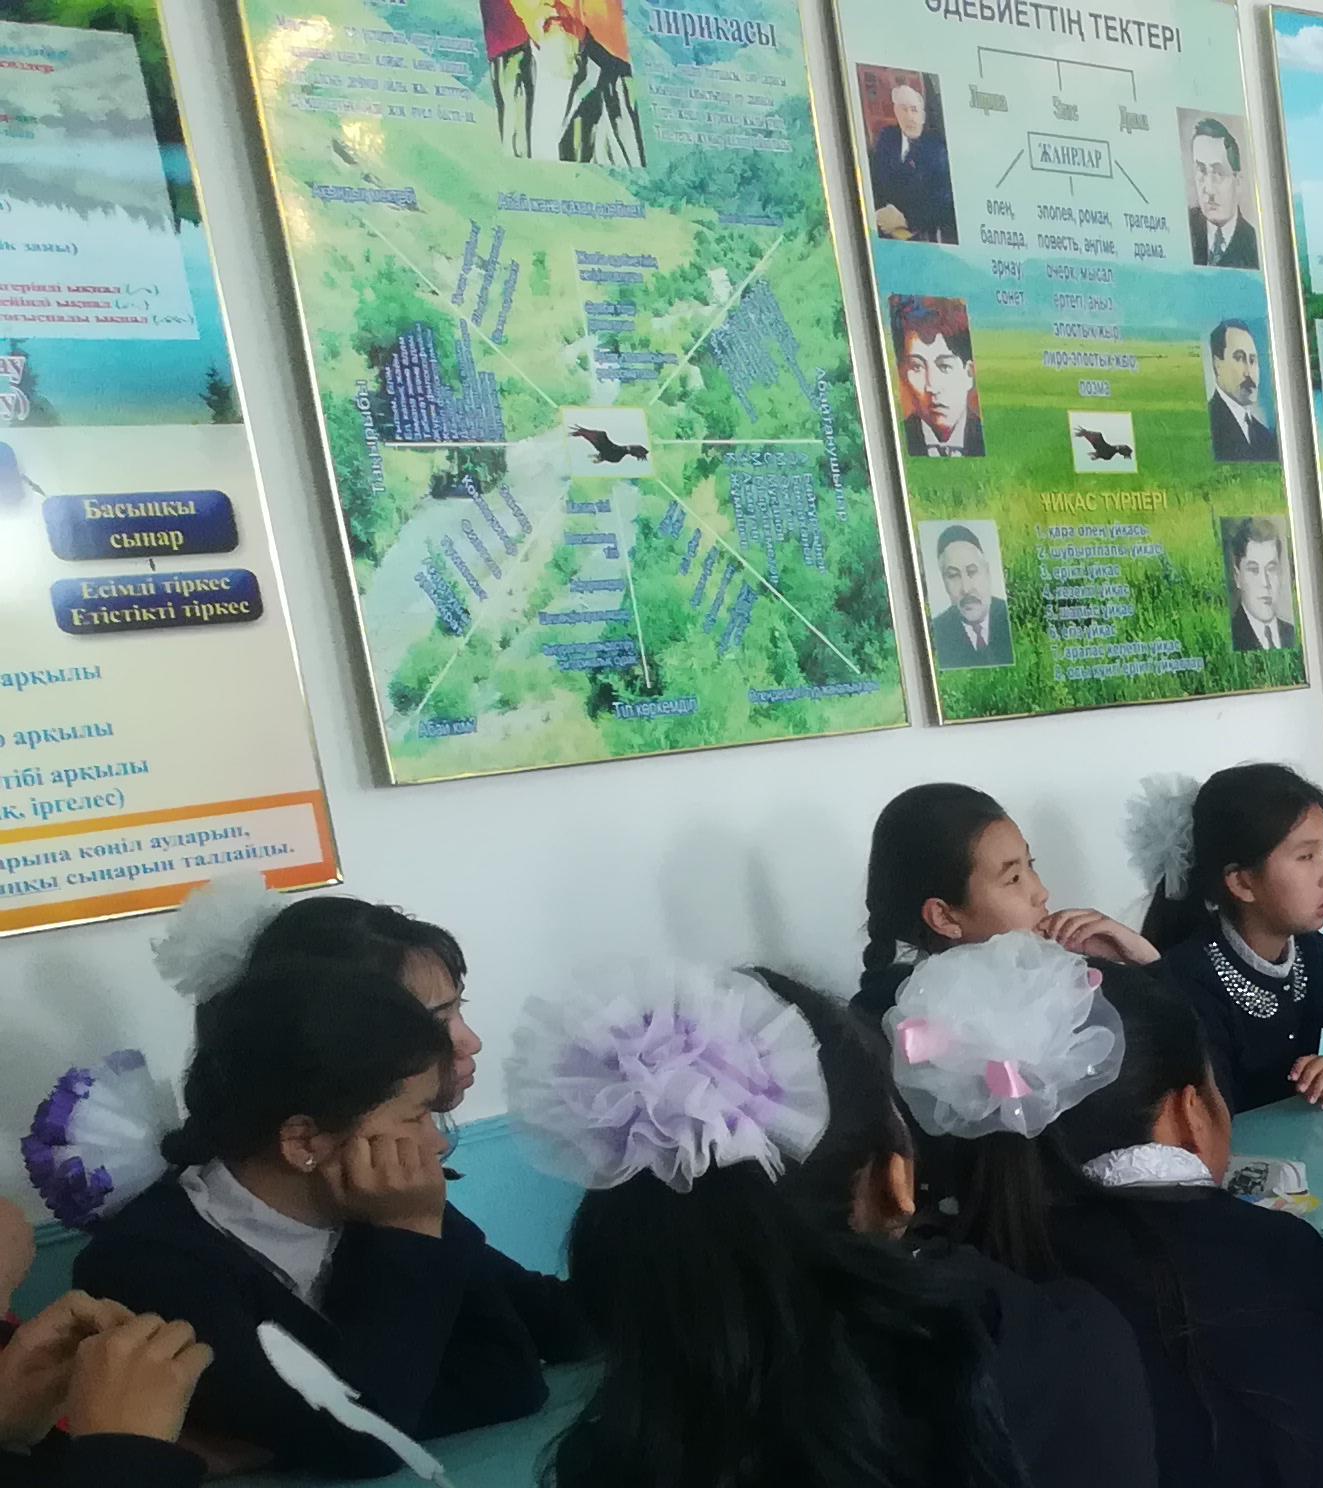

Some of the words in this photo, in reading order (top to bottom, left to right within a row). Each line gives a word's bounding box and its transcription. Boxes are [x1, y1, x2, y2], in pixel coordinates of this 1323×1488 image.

[648, 8, 778, 48] лирикасы
[1088, 12, 1182, 52] ТЕКТЕРІ
[1038, 142, 1102, 169] ЖАНРЛАР
[161, 576, 232, 597] тіркес
[181, 599, 250, 622] тіркес
[13, 722, 115, 750] арқылы
[50, 760, 150, 787] арқылы
